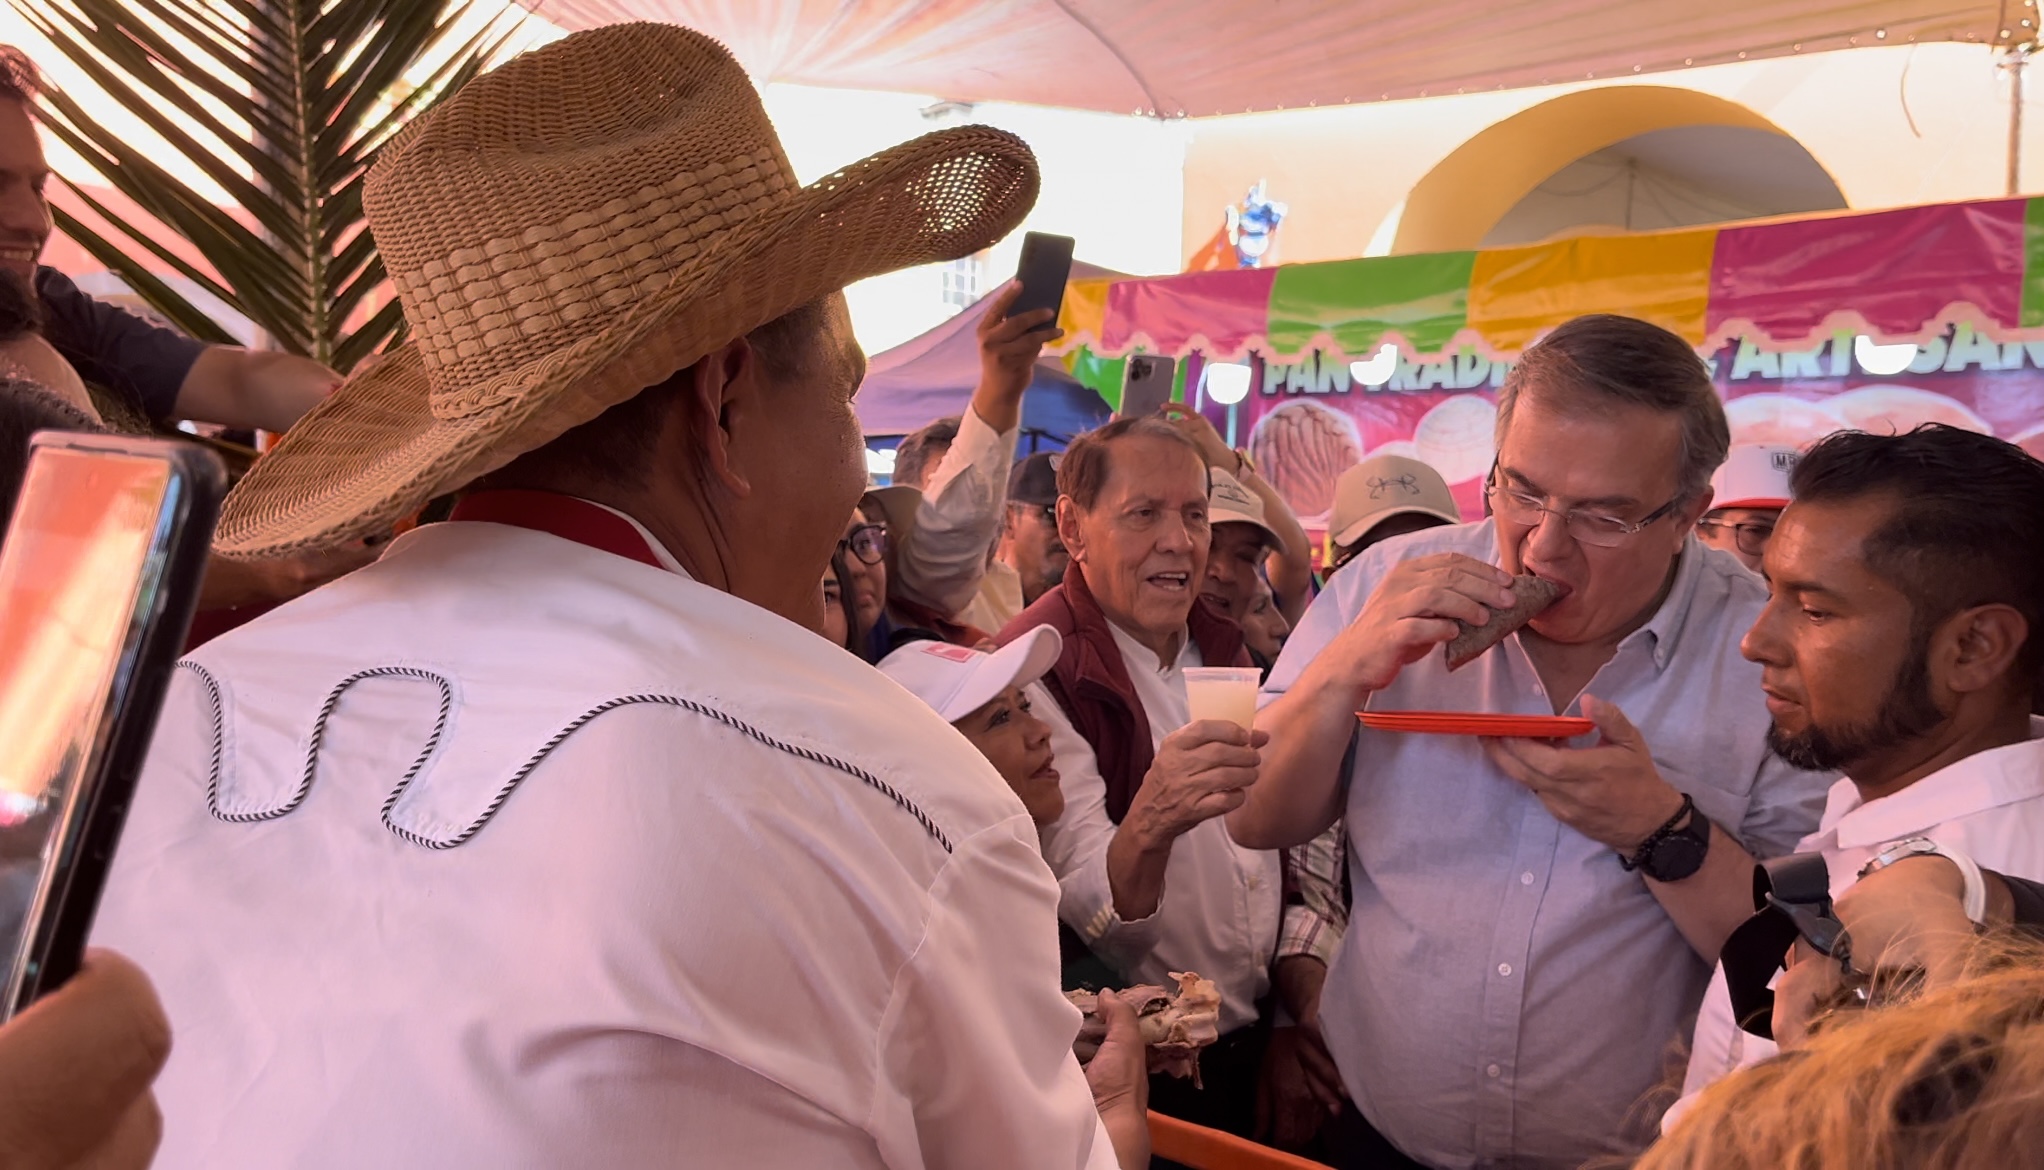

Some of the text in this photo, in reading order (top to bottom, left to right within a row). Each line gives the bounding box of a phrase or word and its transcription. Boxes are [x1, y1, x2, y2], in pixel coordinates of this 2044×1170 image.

[1262, 349, 1350, 394] PAN
[1366, 345, 1513, 392] RADI
[1730, 322, 2044, 380] ARTSAN
